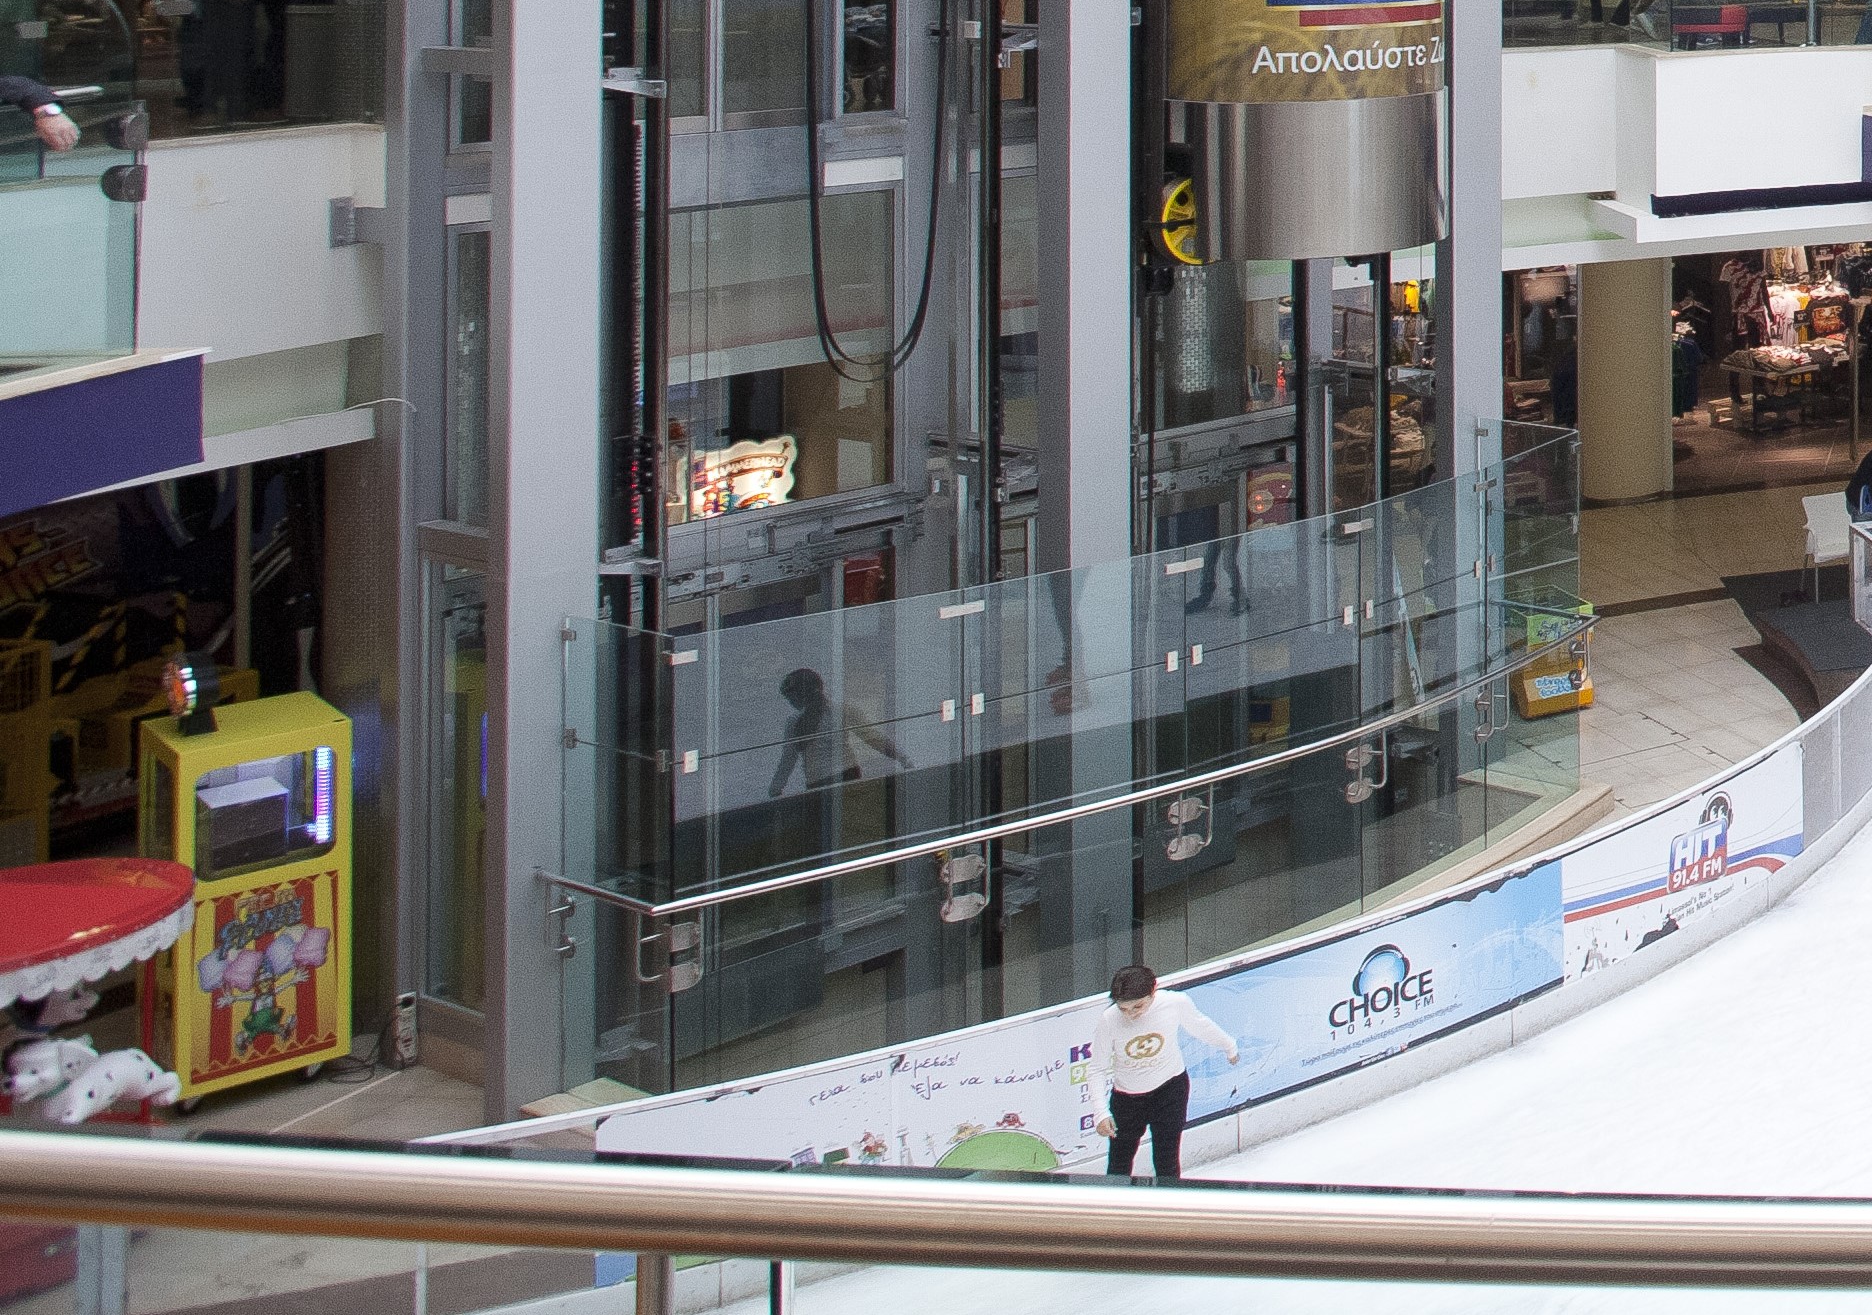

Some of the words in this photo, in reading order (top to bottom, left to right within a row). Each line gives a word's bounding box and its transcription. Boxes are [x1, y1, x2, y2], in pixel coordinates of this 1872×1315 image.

[1252, 38, 1426, 74] Απολαύστε
[1674, 822, 1722, 871] HIT
[1672, 867, 1700, 889] 91.4
[1702, 857, 1722, 880] FM
[1329, 969, 1433, 1028] CHOICE
[1415, 994, 1434, 1011] FM
[896, 1052, 960, 1078] εμεσός!
